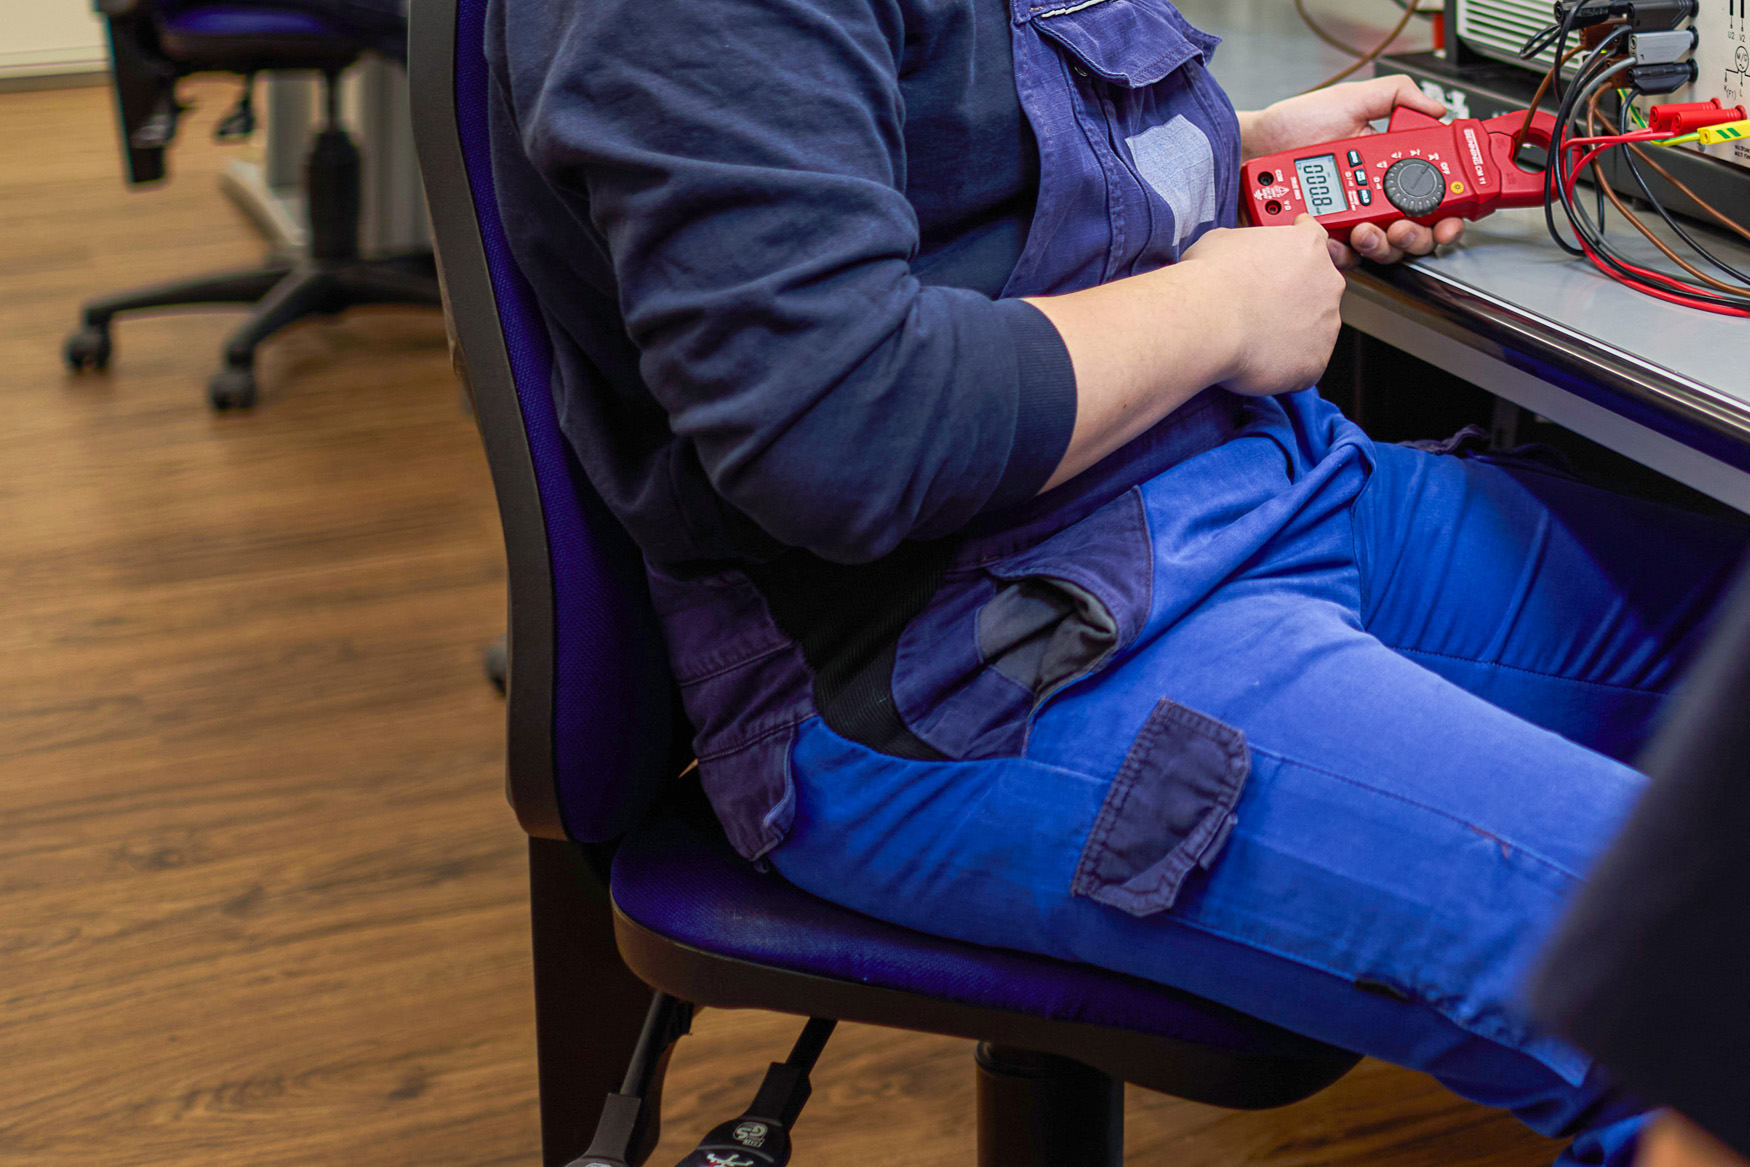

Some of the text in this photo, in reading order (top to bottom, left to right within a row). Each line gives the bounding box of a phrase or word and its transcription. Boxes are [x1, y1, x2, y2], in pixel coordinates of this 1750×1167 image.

[1728, 31, 1735, 40] U2
[1739, 33, 1746, 43] V2
[1463, 128, 1487, 185] BENNING CM 11
[1275, 168, 1284, 182] COM
[1440, 161, 1451, 175] OFF
[1361, 189, 1370, 204] HOLD
[736, 1125, 767, 1140] GS
